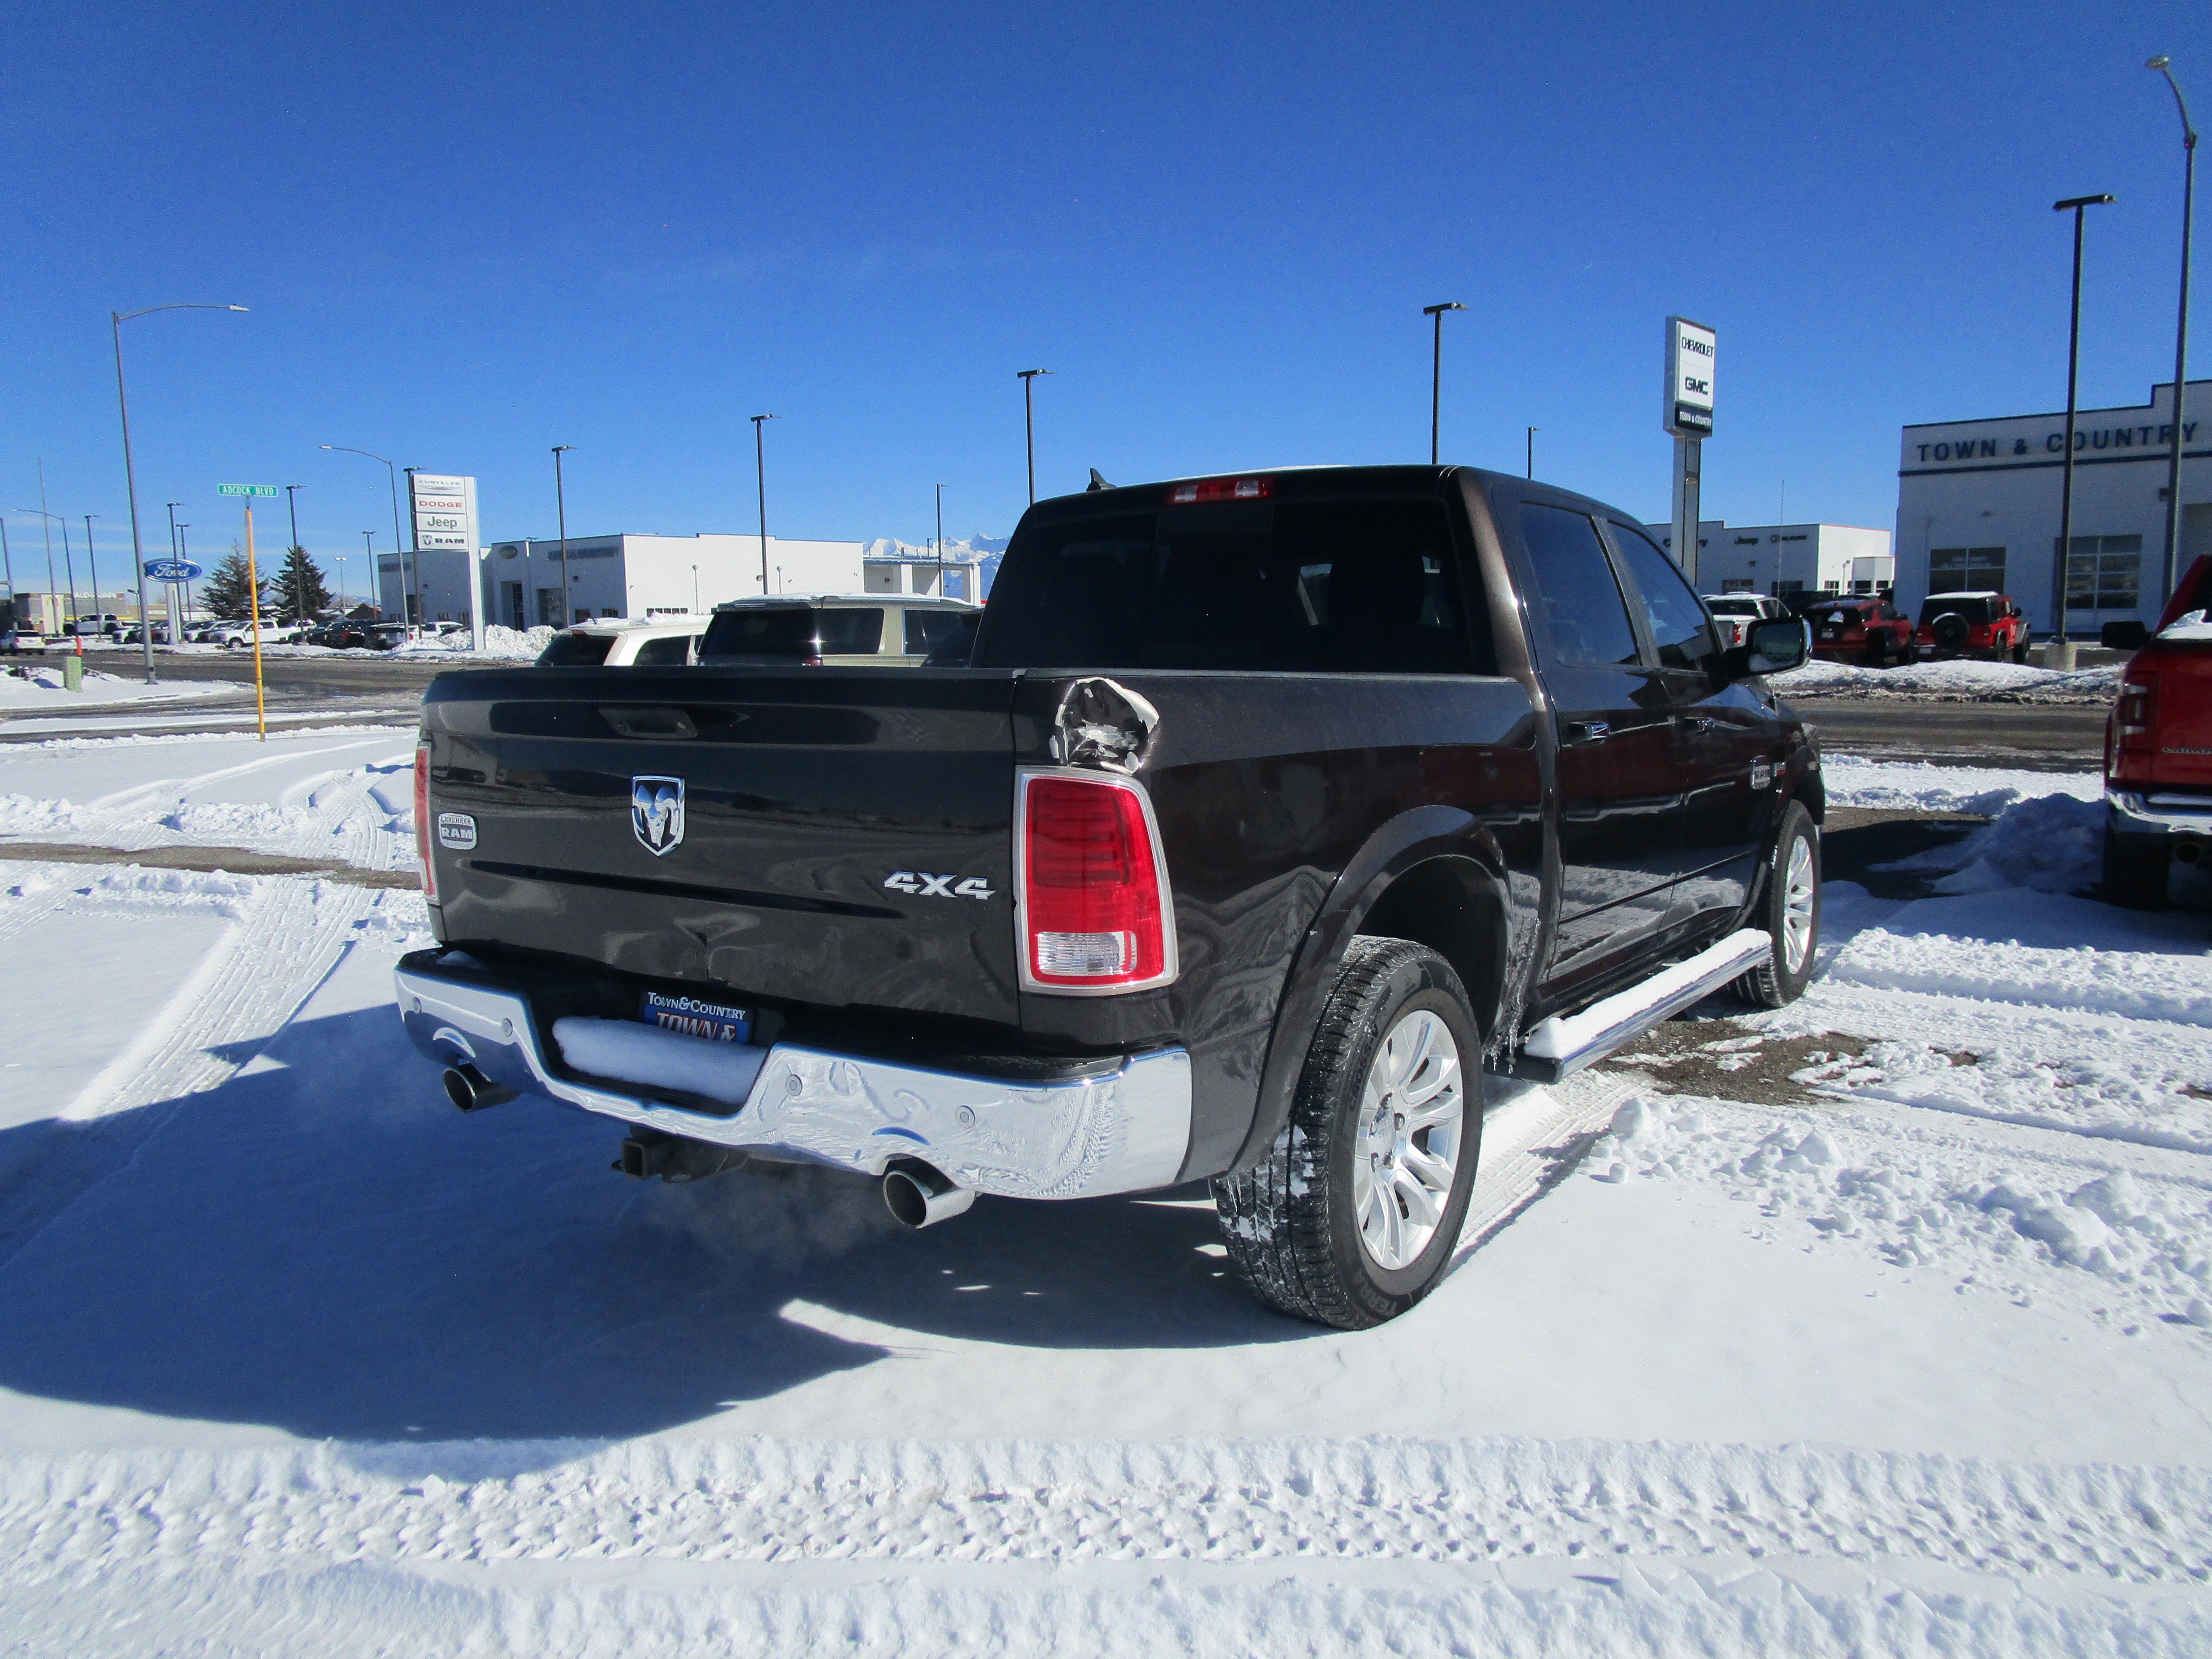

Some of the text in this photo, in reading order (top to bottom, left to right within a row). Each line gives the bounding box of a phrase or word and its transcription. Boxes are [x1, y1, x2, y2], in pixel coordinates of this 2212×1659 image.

[1681, 337, 1714, 358] CHEVROLET
[1685, 376, 1708, 395] GMC
[1917, 421, 2197, 462] TOWN & COUNTRY
[223, 486, 274, 495] ADCOCK BLVD
[427, 516, 458, 529] Jeep
[155, 563, 190, 577] Ford
[441, 827, 472, 839] RAM
[656, 1012, 718, 1040] TOWN
